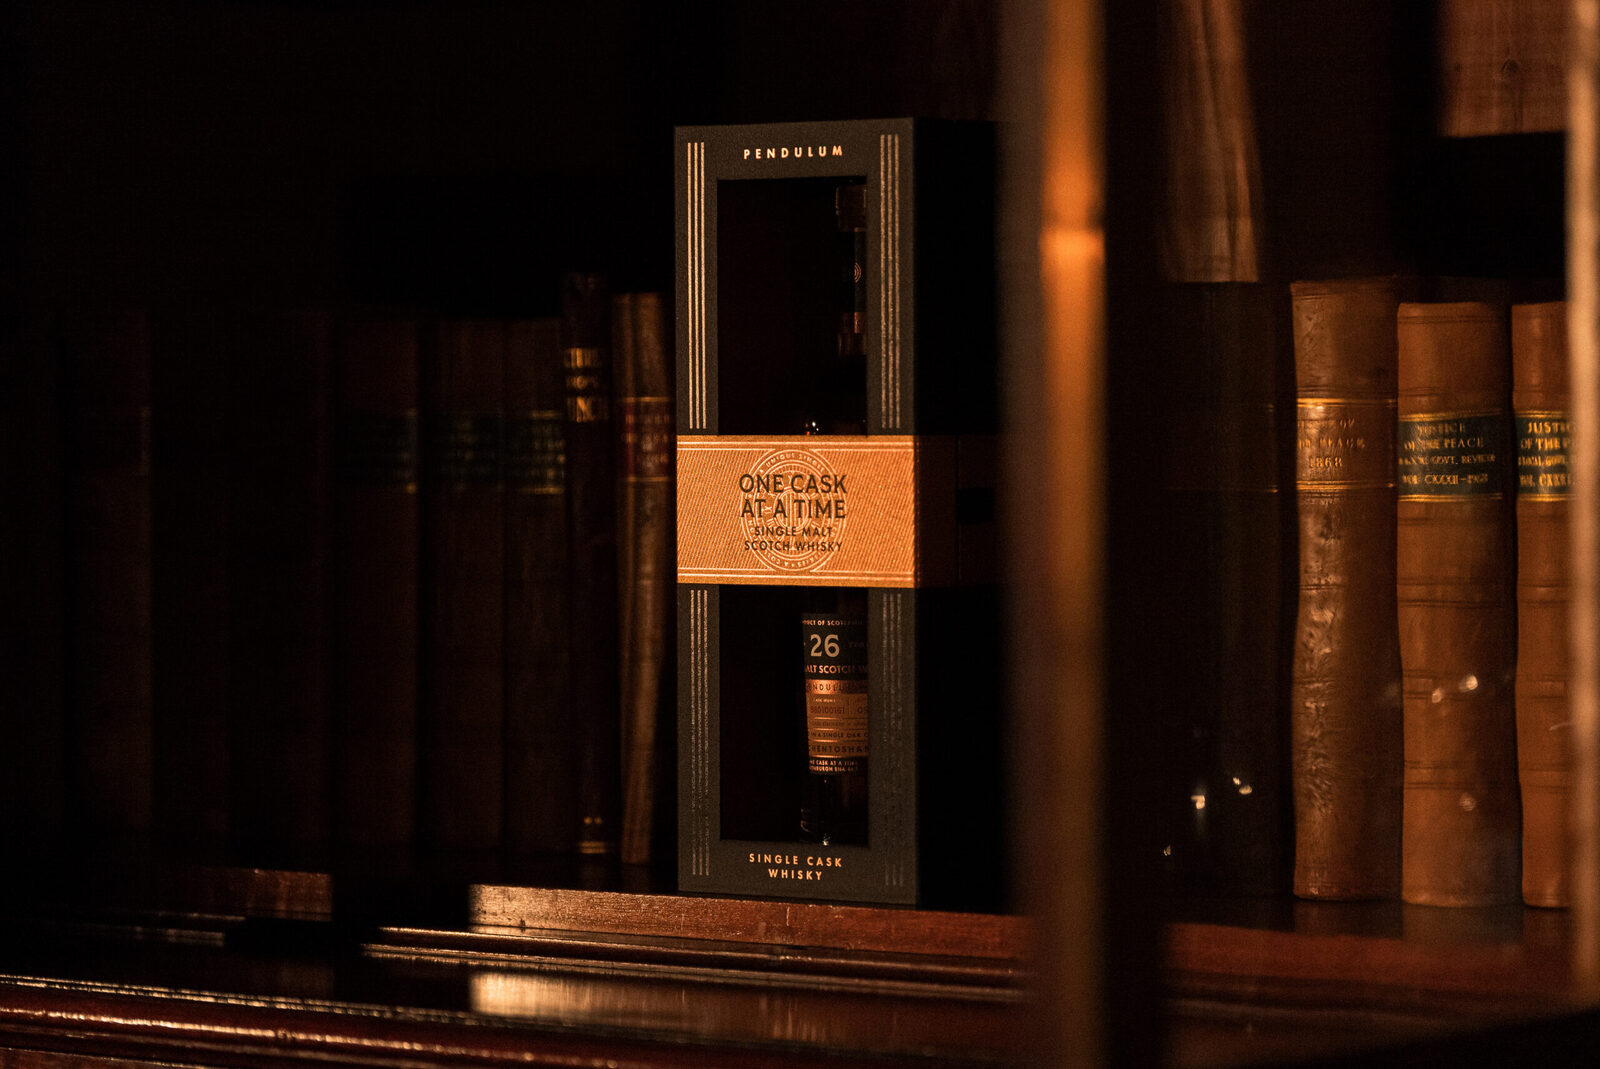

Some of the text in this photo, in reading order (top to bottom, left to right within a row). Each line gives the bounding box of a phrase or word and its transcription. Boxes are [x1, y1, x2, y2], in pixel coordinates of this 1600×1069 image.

[744, 145, 843, 160] PENDULUM
[1444, 436, 1484, 448] PEACE
[1536, 438, 1560, 450] THE
[1309, 456, 1344, 469] 1868
[740, 474, 848, 494] ONE CASK
[740, 500, 847, 518] AT A TIME
[754, 526, 797, 536] SINGLE
[801, 526, 832, 537] MALT
[744, 540, 842, 552] SCOTCH WHISKY
[810, 634, 840, 658] 26
[748, 853, 842, 868] SINGLE CASK
[768, 868, 823, 880] WHISKY
